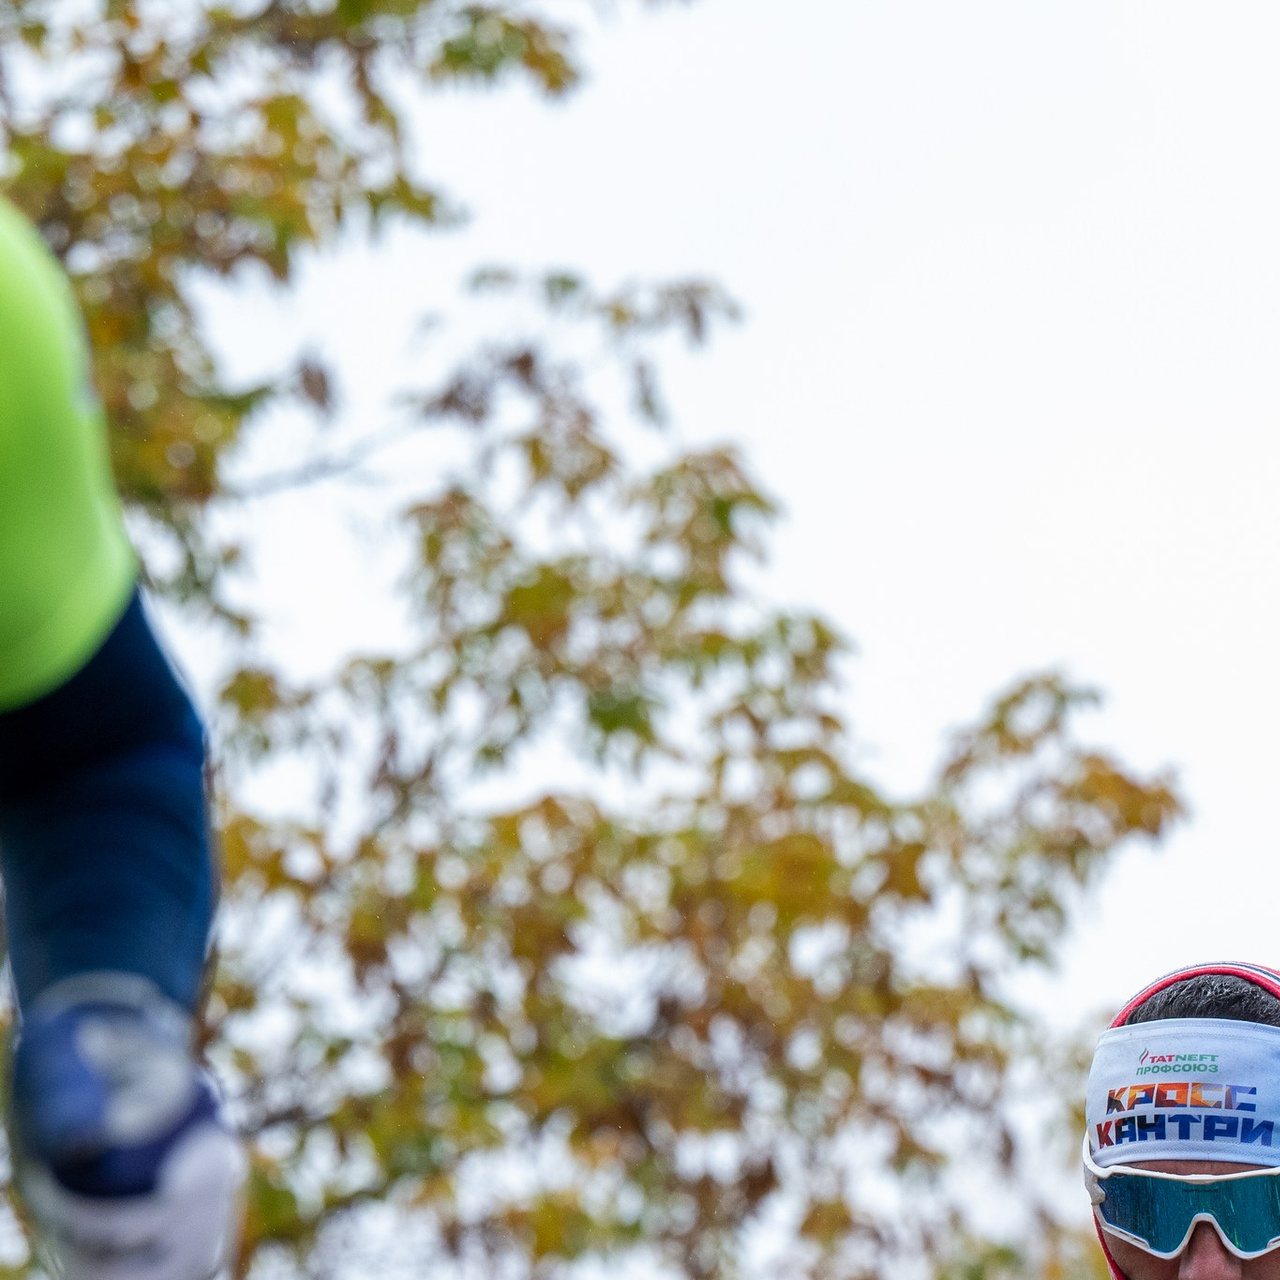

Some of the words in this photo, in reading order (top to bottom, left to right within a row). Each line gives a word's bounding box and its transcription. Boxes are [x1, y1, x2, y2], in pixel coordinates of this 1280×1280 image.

[1136, 1063, 1219, 1075] ПРОФСОЮЗ
[1149, 1054, 1219, 1064] TATNEFT
[1106, 1082, 1257, 1116] КРОСС
[1096, 1113, 1275, 1150] КАНТРИ
